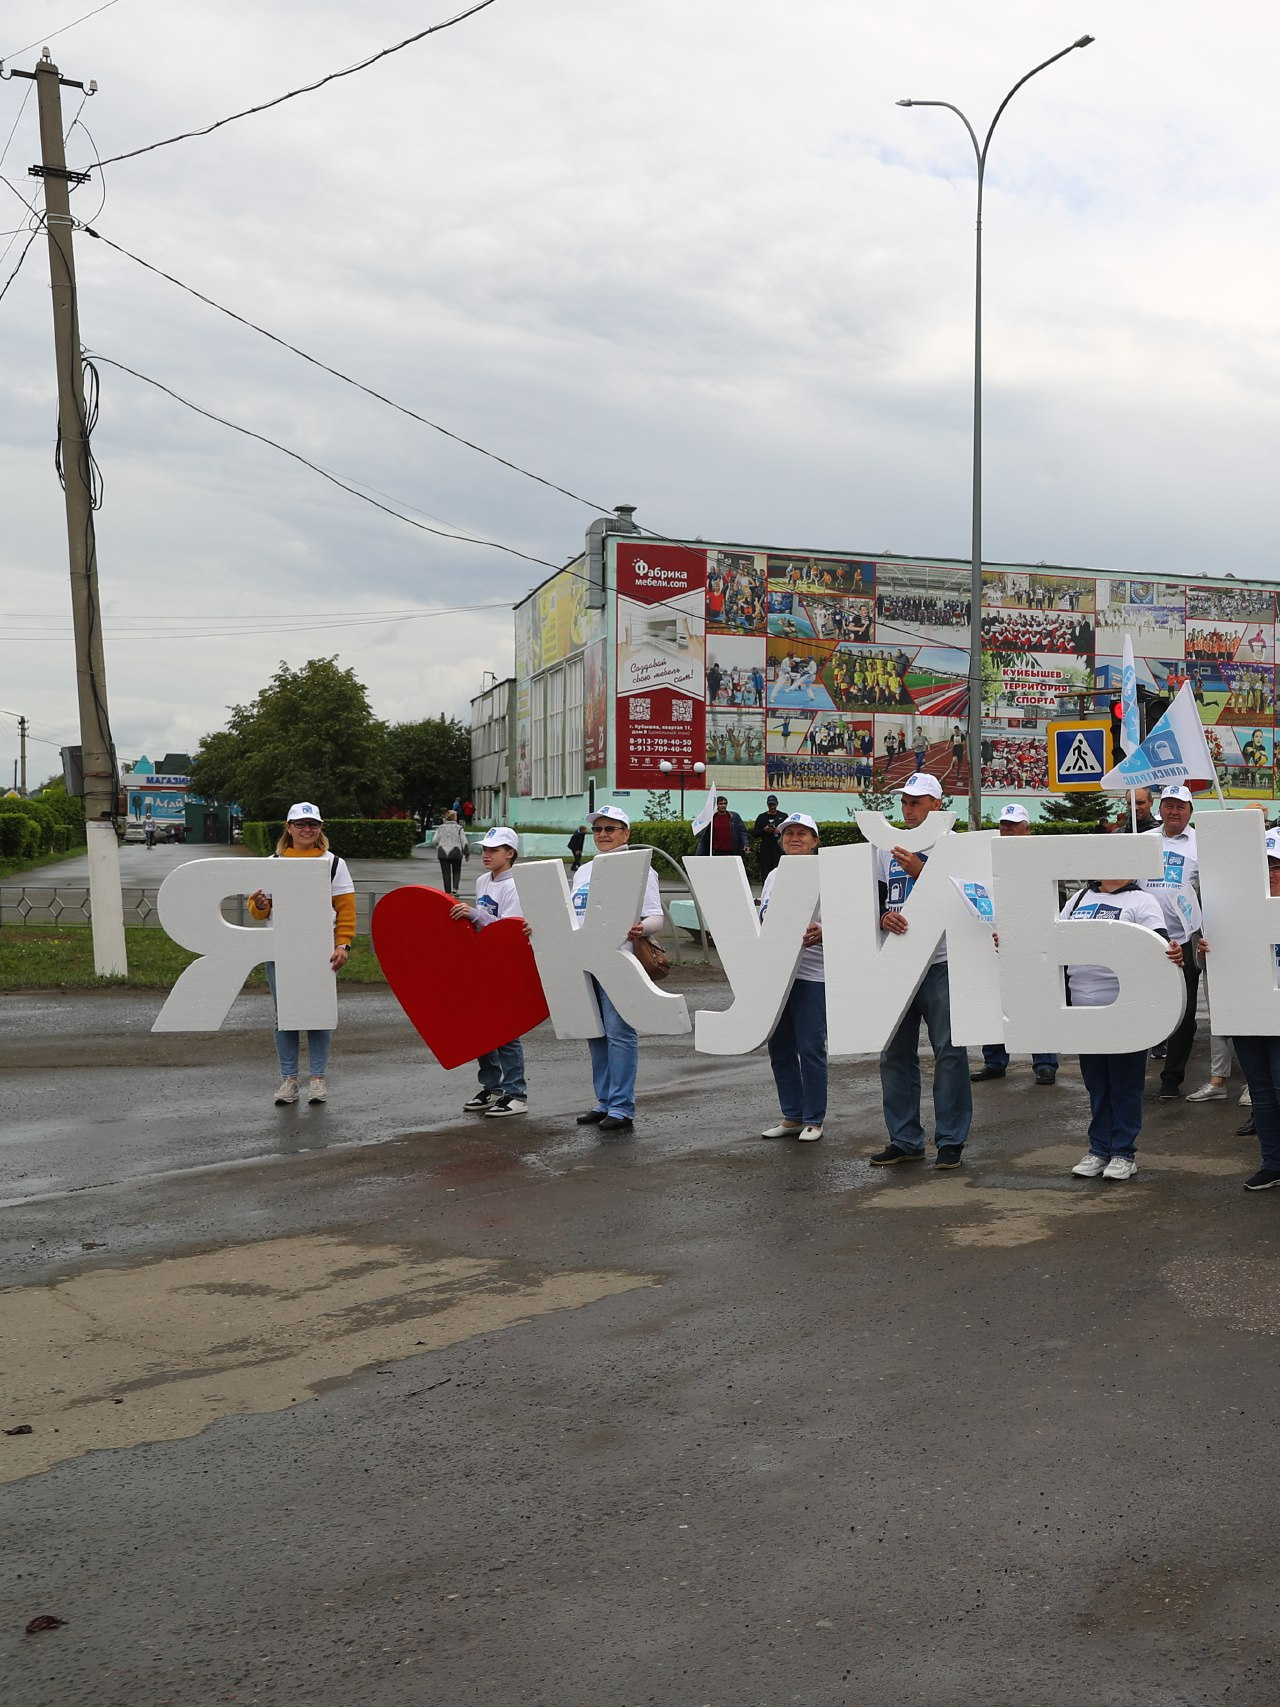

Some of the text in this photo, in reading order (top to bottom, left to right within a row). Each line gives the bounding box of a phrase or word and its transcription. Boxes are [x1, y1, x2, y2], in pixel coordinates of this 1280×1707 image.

[633, 558, 688, 580] Фабрика
[635, 578, 688, 588] мебели.com
[630, 658, 667, 674] Создавай
[1003, 667, 1062, 679] КУЙБЫШЕВ
[632, 667, 681, 684] свою мебель
[673, 669, 693, 683] сам!
[1004, 683, 1068, 692] ТЕРРИТОРИЯ
[151, 857, 339, 1033] Я
